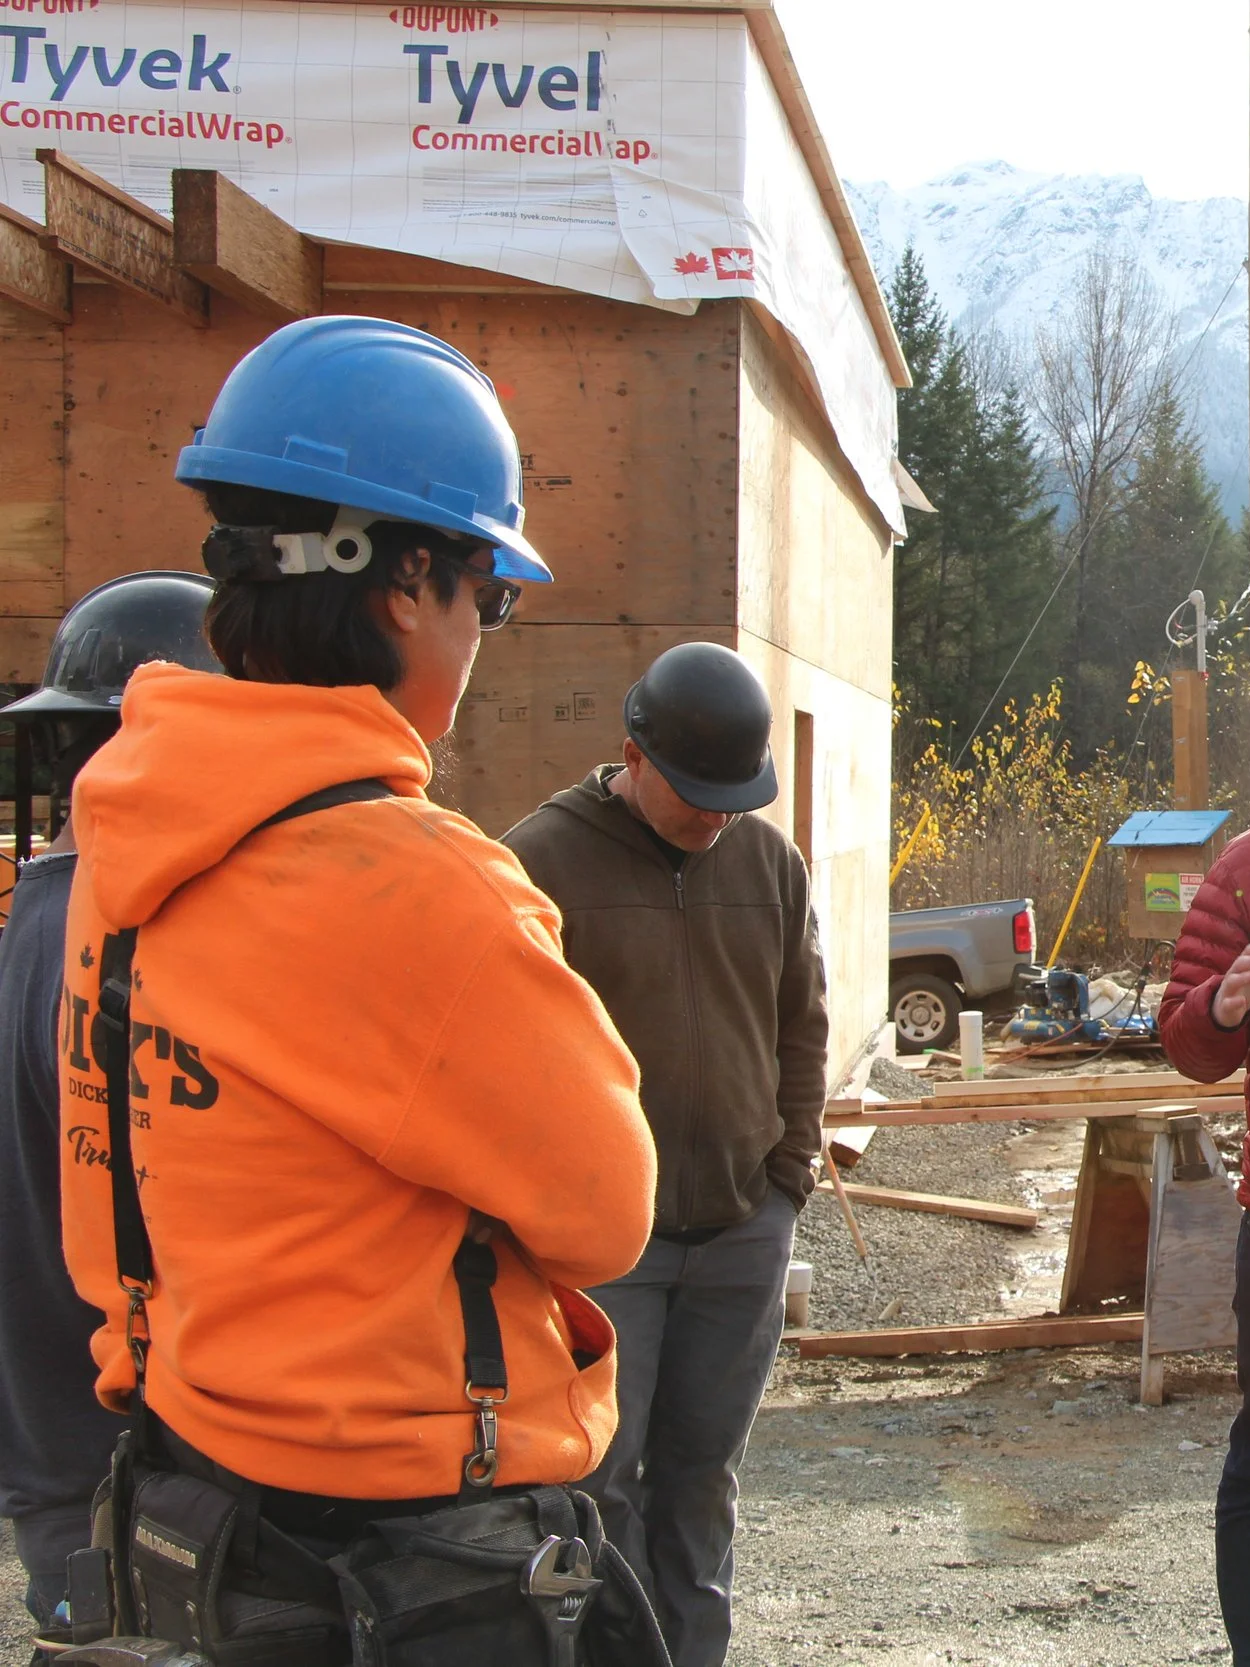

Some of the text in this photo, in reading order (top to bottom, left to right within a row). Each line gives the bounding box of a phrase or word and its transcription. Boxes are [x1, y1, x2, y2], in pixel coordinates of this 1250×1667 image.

[403, 6, 488, 33] DUPONT
[0, 25, 232, 101] Tyvek
[1, 101, 285, 149] CommercialWrap
[412, 125, 651, 165] Commercialap
